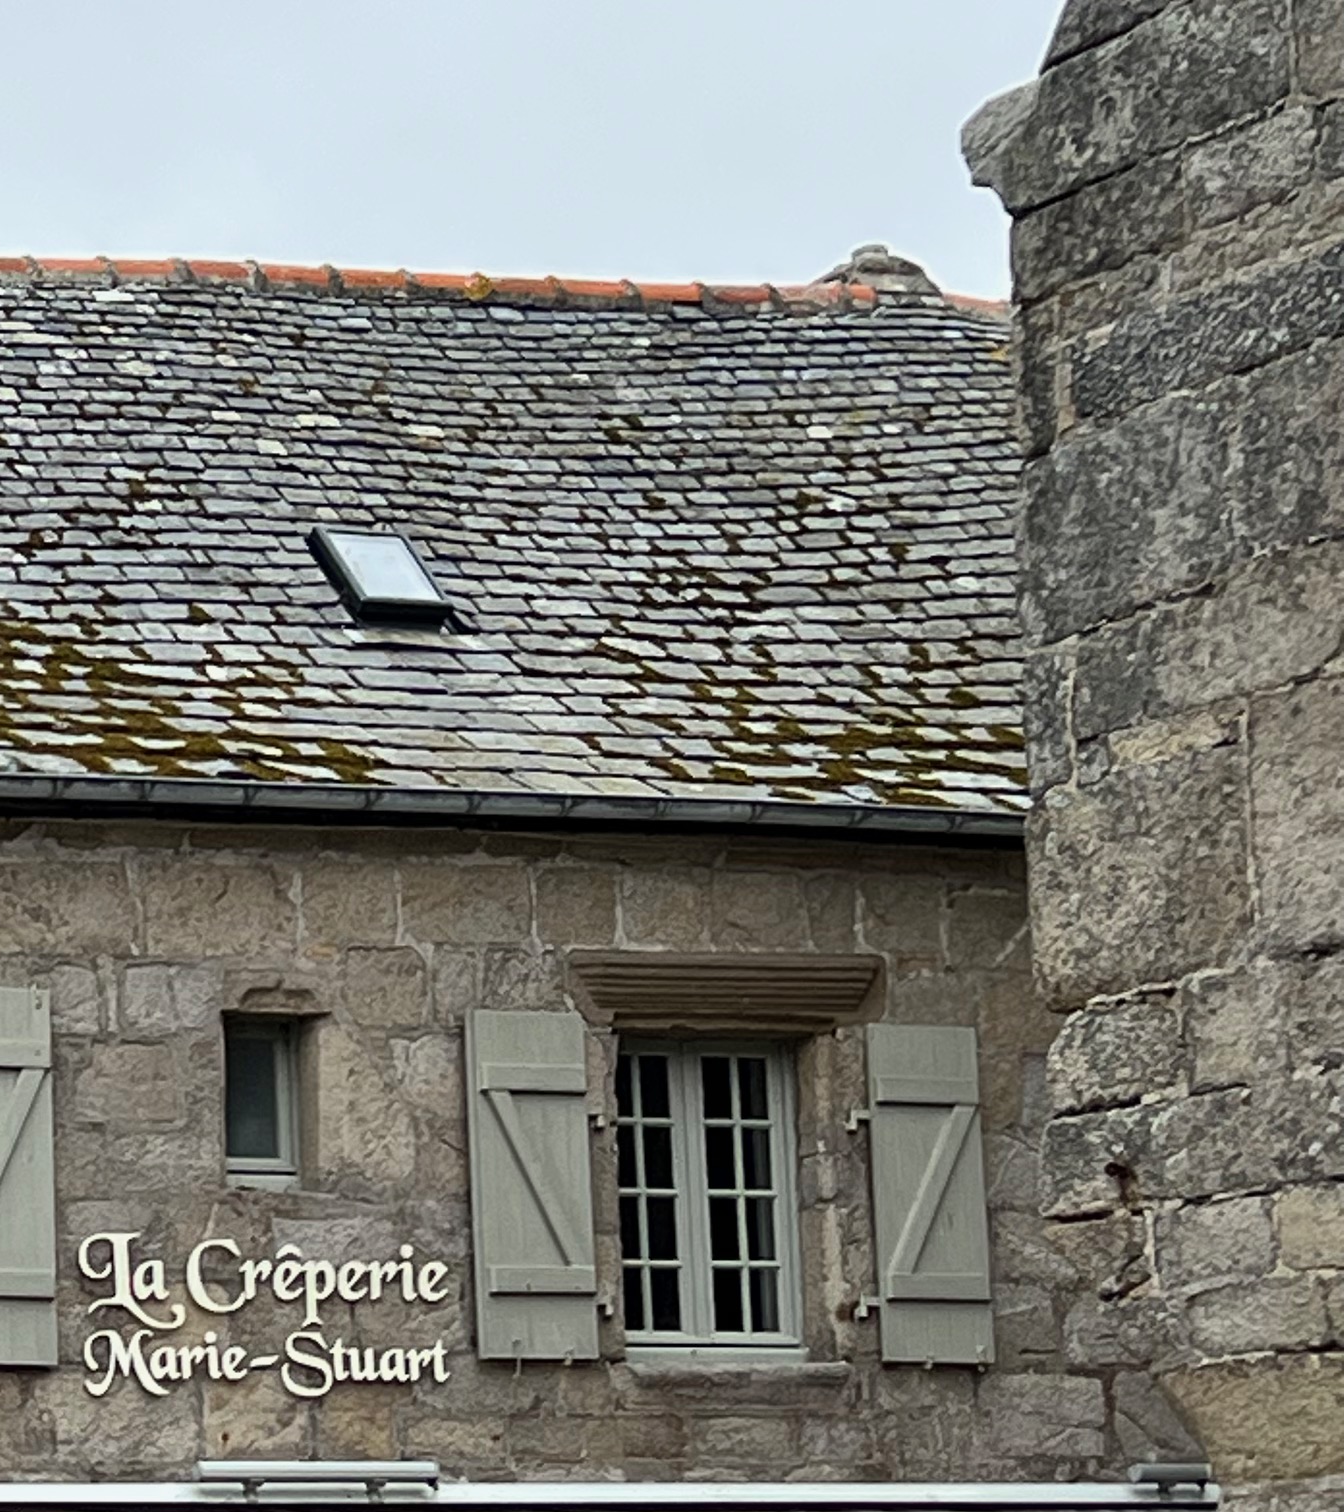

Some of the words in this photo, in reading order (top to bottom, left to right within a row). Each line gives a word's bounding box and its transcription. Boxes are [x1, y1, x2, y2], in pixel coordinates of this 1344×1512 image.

[78, 1231, 186, 1329] La
[186, 1238, 449, 1329] Crêperie
[83, 1329, 450, 1397] Marie-Stuart
